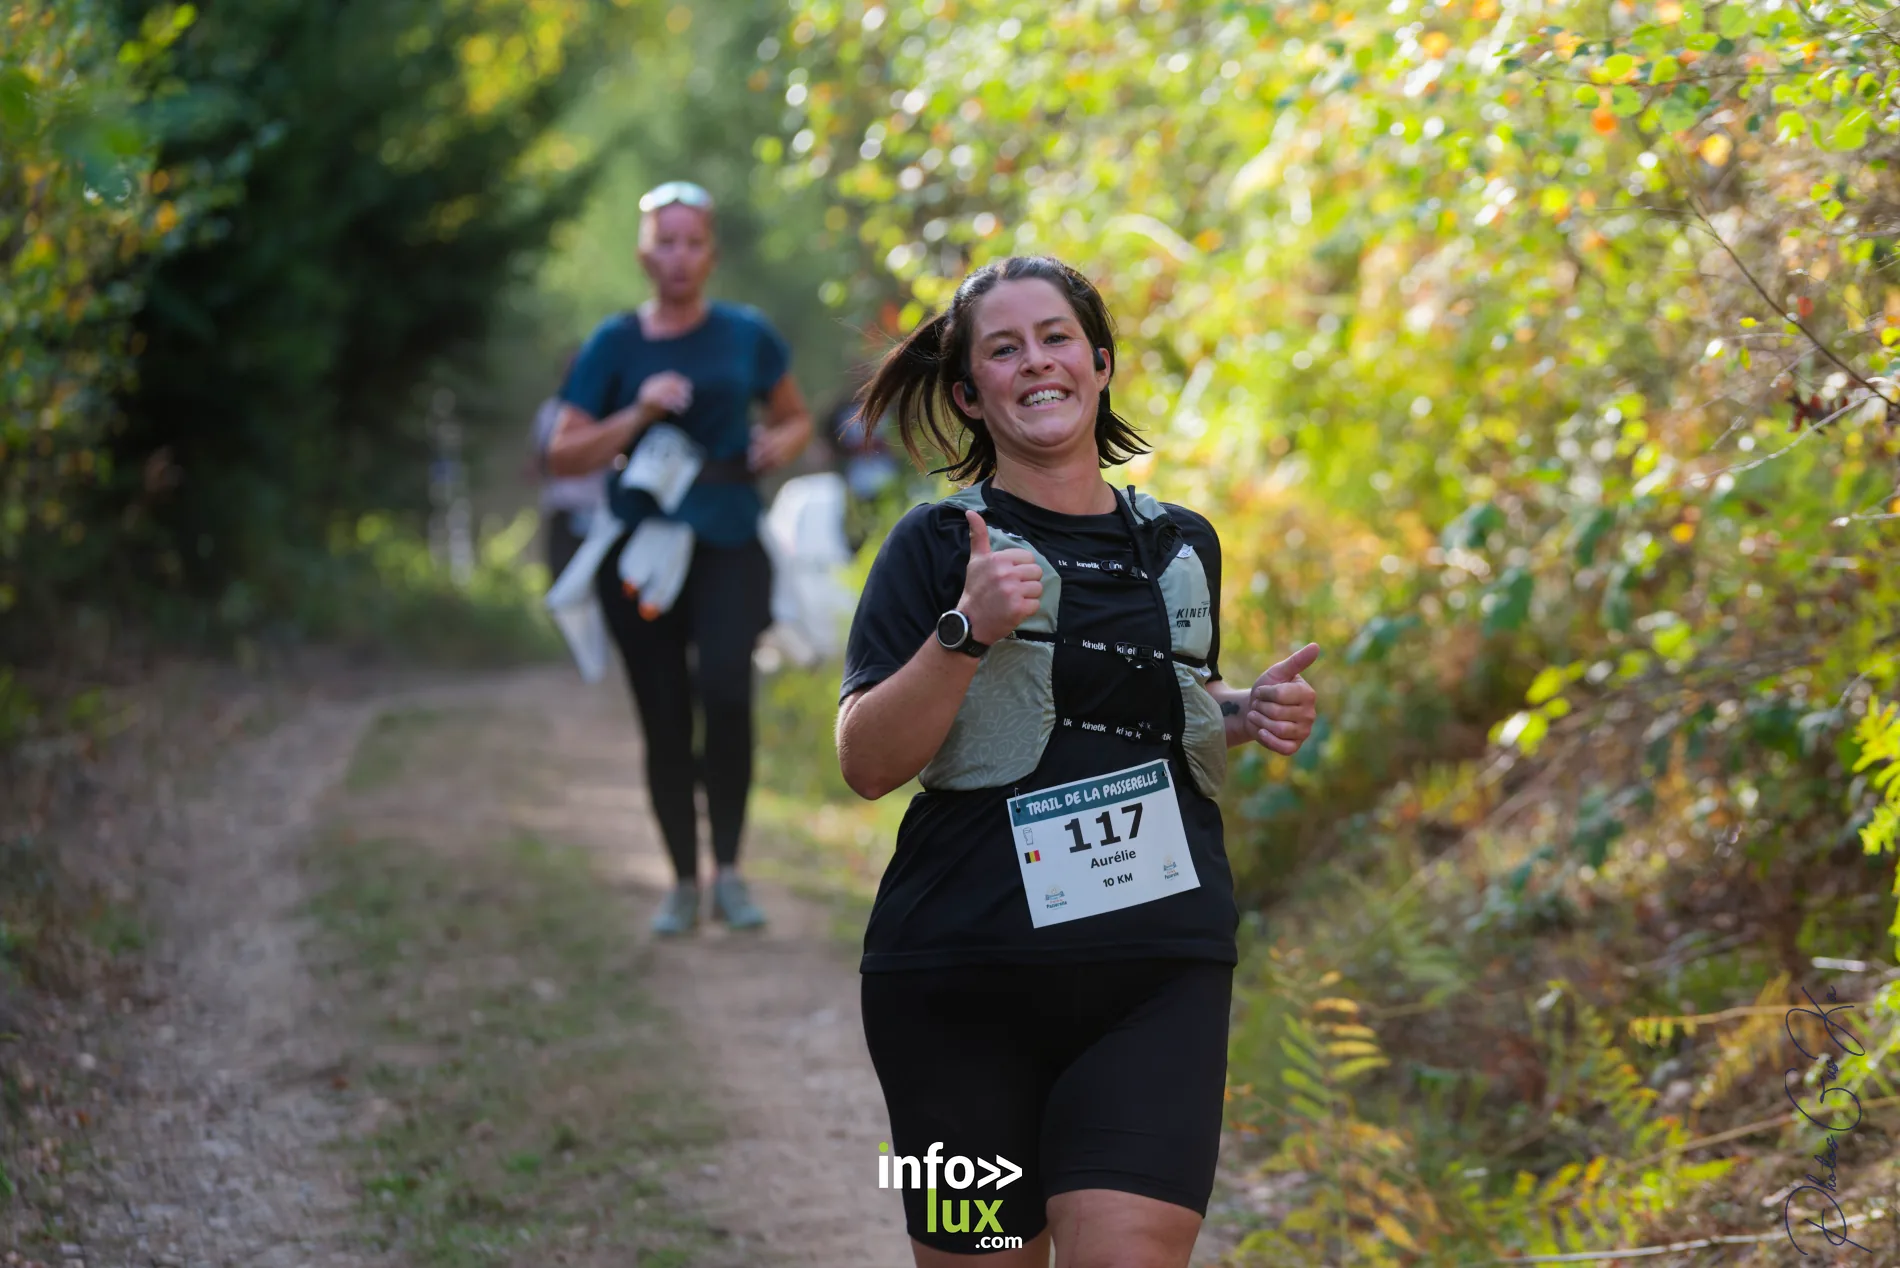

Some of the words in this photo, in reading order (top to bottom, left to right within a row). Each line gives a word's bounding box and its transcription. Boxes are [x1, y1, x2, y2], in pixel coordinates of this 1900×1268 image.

[1082, 640, 1107, 652] kinetik
[1082, 721, 1107, 733] kinetik
[1025, 798, 1063, 816] TRAIL
[1064, 791, 1082, 807] DE
[1083, 787, 1101, 803] LA
[1102, 770, 1159, 799] PASSERELLE
[1064, 802, 1144, 853] 117
[1090, 849, 1137, 869] Aurélie
[1102, 877, 1115, 887] 10
[1116, 873, 1134, 885] KM
